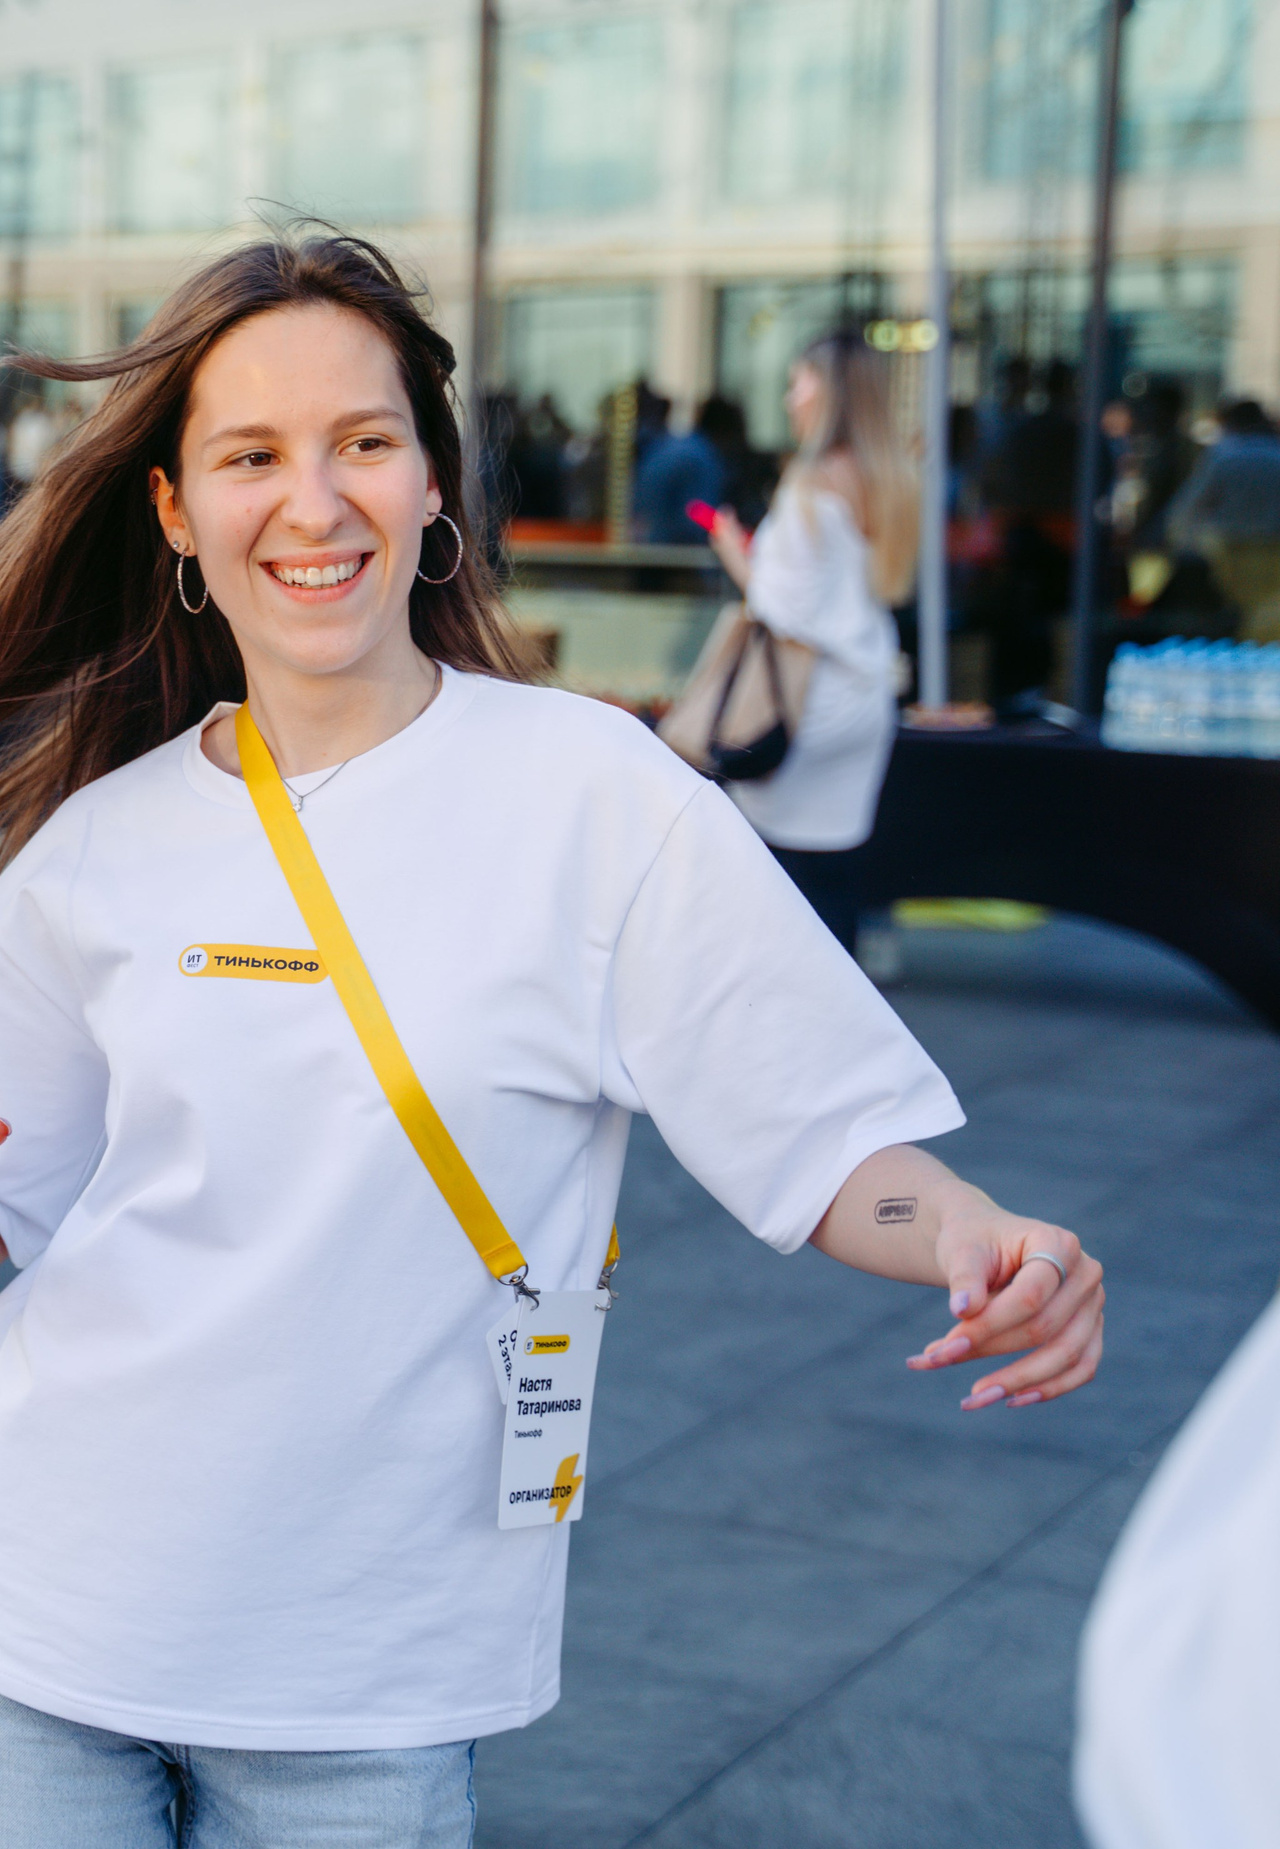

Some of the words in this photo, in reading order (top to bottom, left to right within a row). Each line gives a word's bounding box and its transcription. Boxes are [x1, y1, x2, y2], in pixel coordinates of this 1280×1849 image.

[187, 954, 203, 963] ИТ
[214, 955, 320, 972] ТИНЬКОФФ
[535, 1340, 567, 1348] ТИНЬКОФФ
[519, 1377, 552, 1393] Настя
[517, 1399, 581, 1418] Татаринова
[514, 1428, 543, 1438] Тинькофф
[509, 1485, 572, 1504] ОРГАНИЗАТОР
